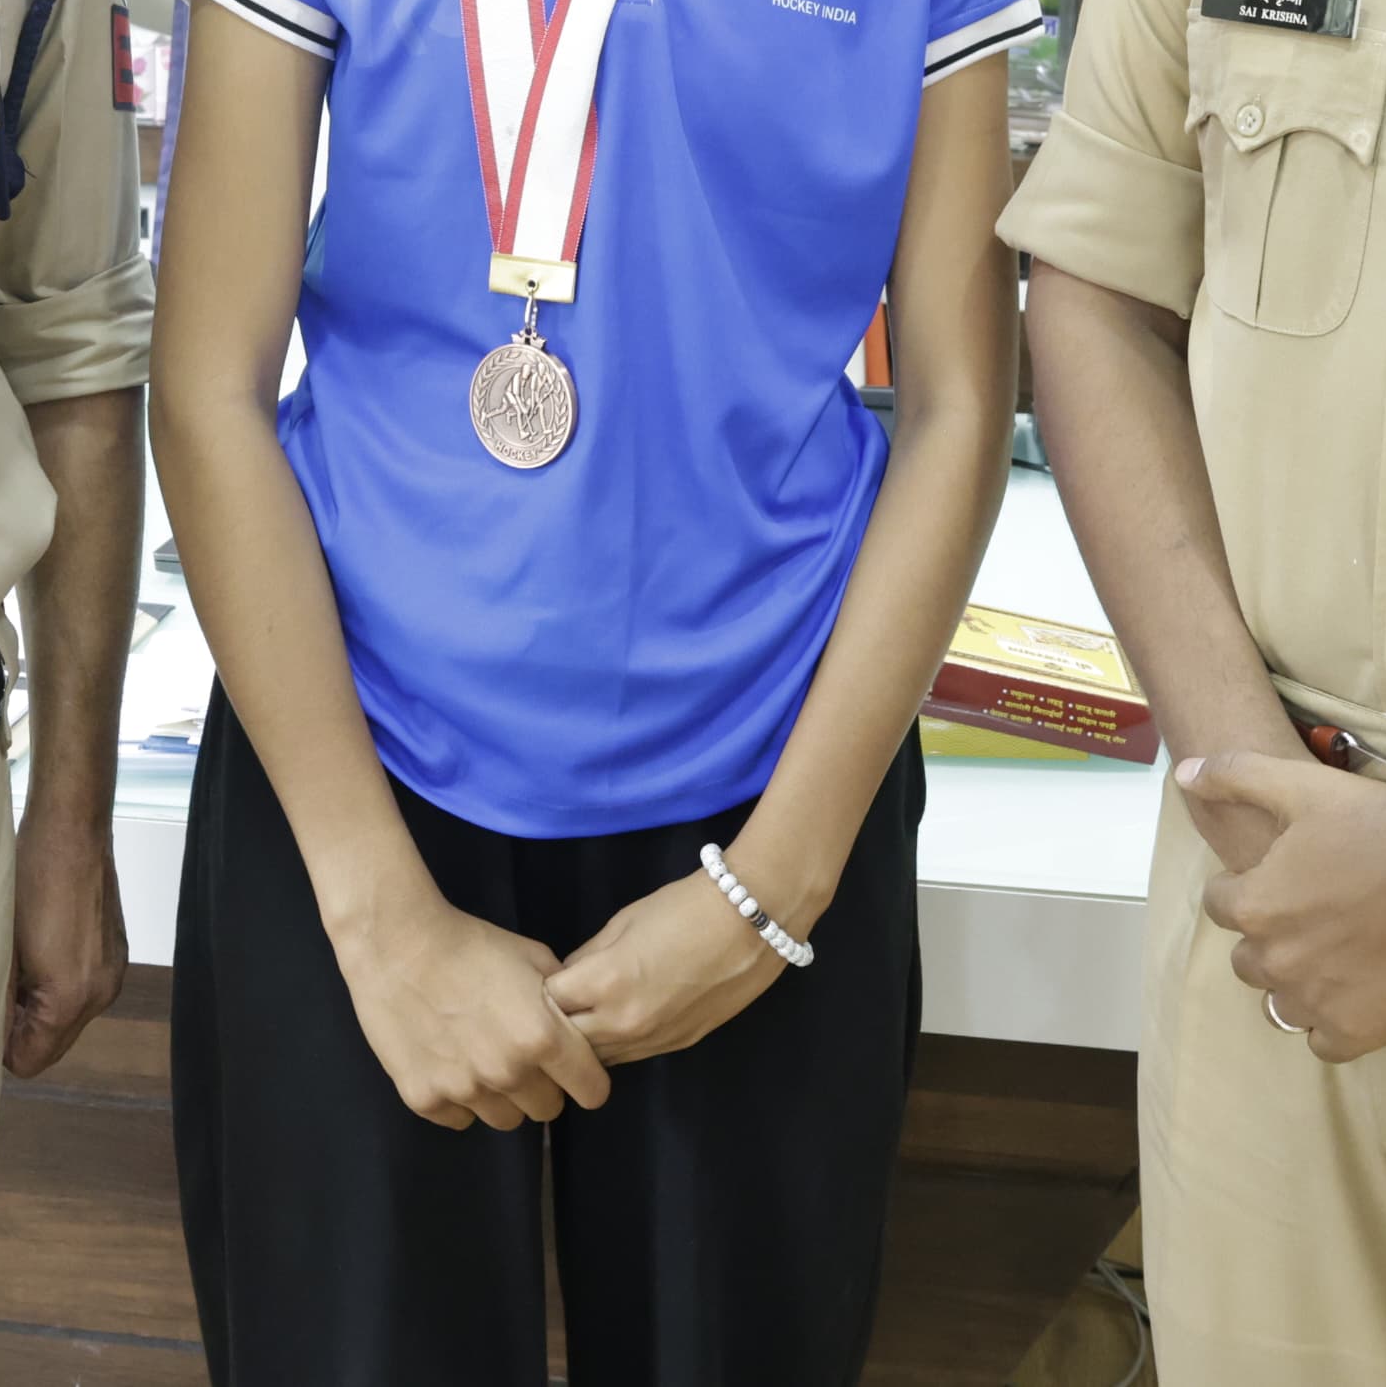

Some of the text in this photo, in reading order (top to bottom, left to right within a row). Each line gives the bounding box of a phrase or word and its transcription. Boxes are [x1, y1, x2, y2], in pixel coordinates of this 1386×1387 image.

[822, 5, 857, 25] INDIA
[1239, 5, 1308, 26] SAI KRISHNA
[494, 438, 540, 461] HOCKEY
